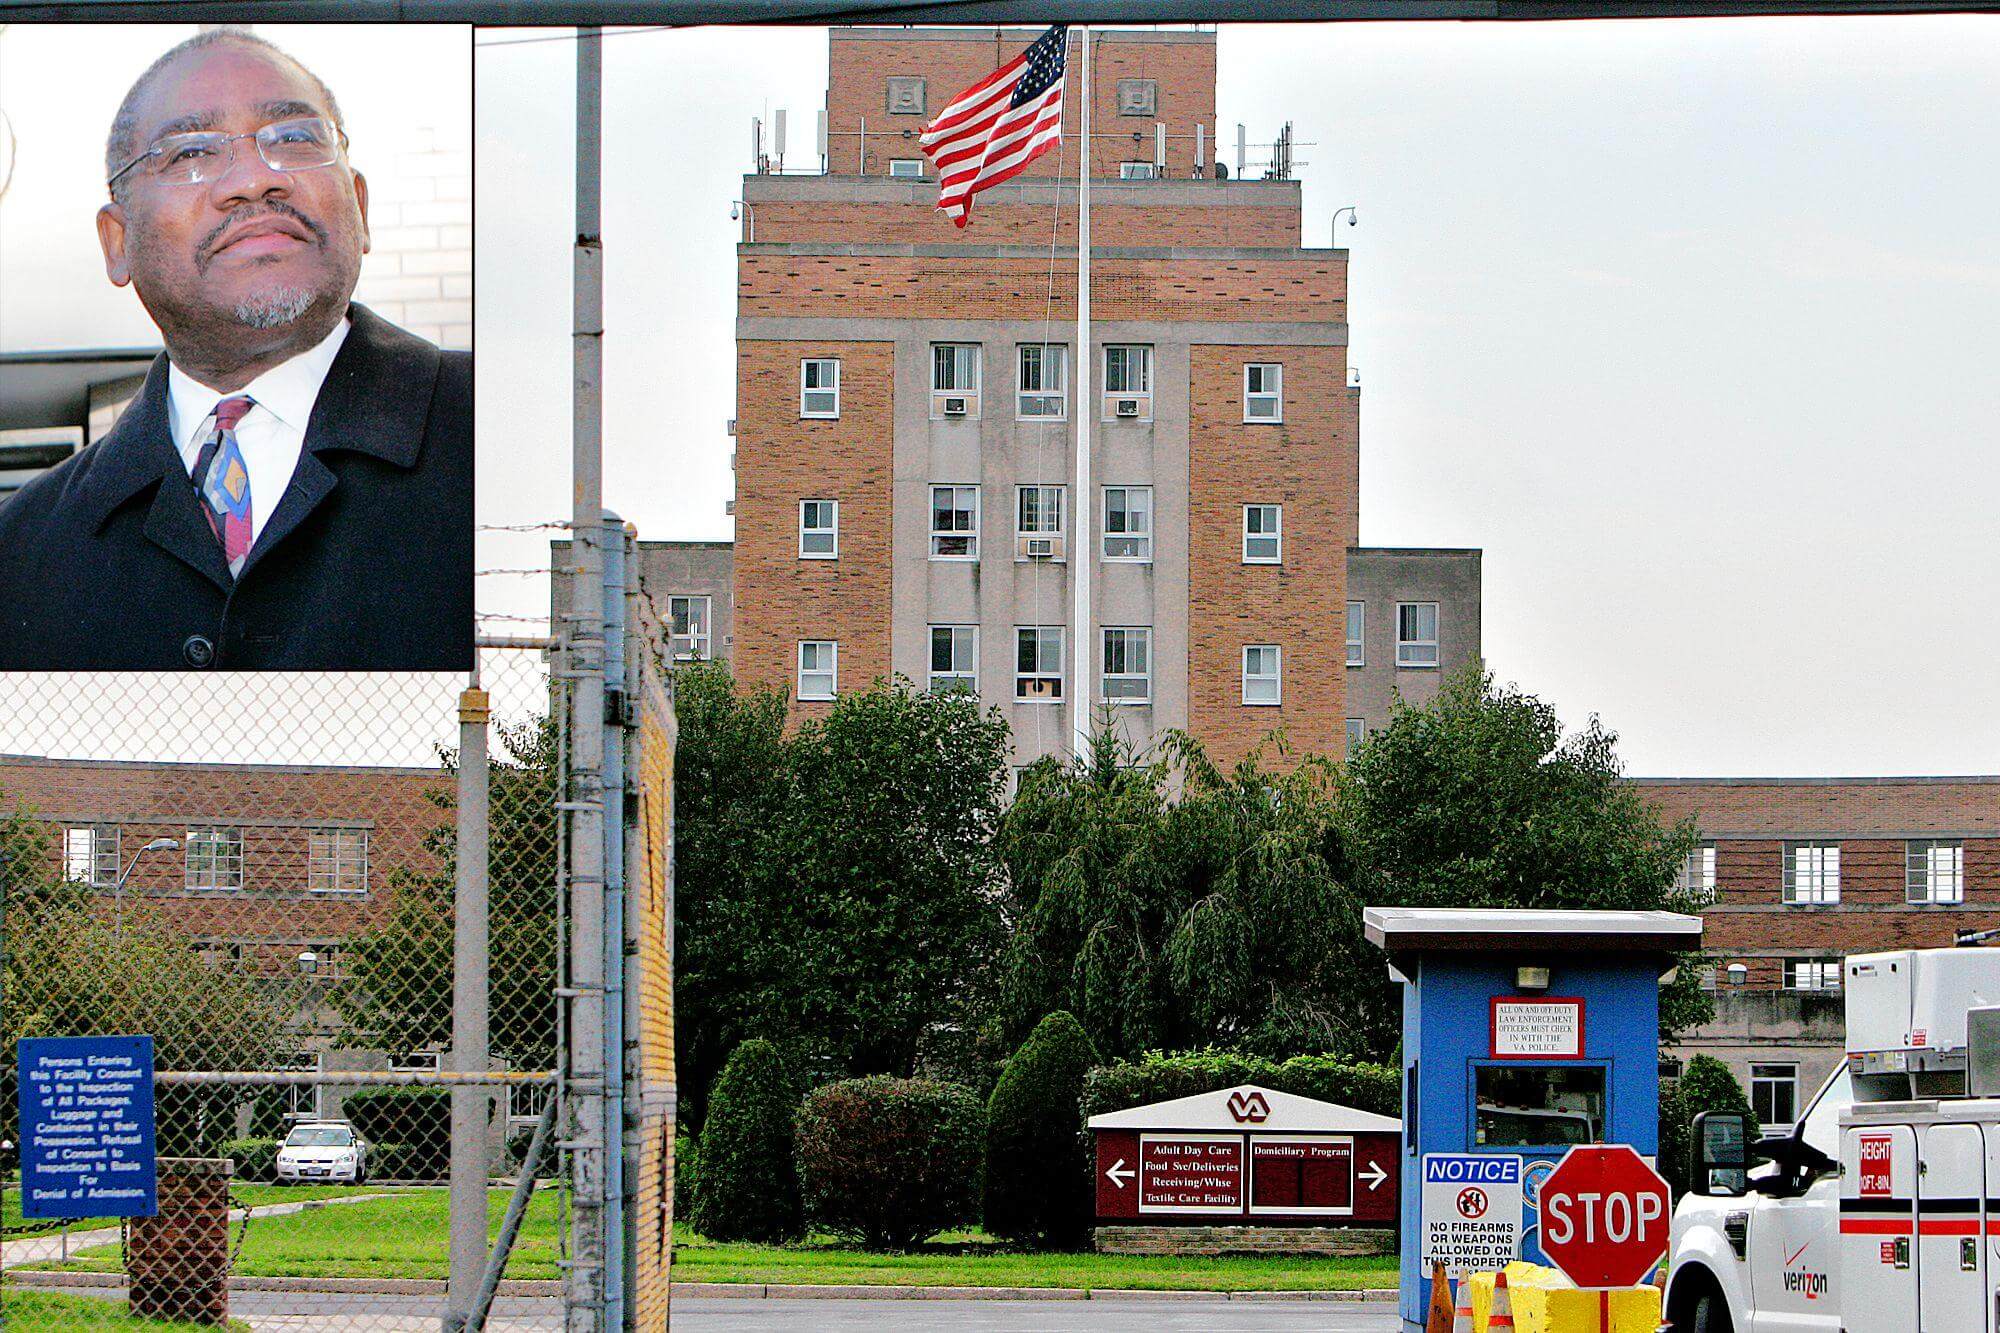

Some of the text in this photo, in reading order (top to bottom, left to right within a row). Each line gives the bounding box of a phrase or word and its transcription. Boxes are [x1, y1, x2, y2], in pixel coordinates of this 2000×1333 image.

[1554, 1006, 1572, 1014] DUTY
[1499, 1015, 1573, 1023] LAW ENFORCEMENT
[1499, 1024, 1573, 1033] OFFICERS MUST CHECK
[1509, 1034, 1562, 1042] IN WITH THE
[39, 1056, 132, 1067] Persons Entering
[30, 1068, 142, 1081] this Facility Consent
[39, 1082, 134, 1094] to the Inspection
[42, 1097, 54, 1106] of
[58, 1096, 73, 1106] All
[1227, 1092, 1271, 1122] VA
[50, 1109, 123, 1121] Luggage and
[36, 1121, 139, 1133] Containers in their
[102, 1135, 142, 1145] Refusal
[45, 1148, 124, 1160] of Consent to
[1153, 1145, 1232, 1156] Adult Day Care
[1254, 1146, 1350, 1157] Domiciliary Program
[1860, 1141, 1891, 1161] HEIGHT
[36, 1163, 91, 1173] Inspection
[111, 1161, 141, 1171] Basis
[1145, 1161, 1239, 1172] Food Svc/Deliveries
[1429, 1161, 1517, 1180] NOTICE
[79, 1175, 98, 1185] For
[1152, 1177, 1232, 1189] Receiving/Whse
[33, 1189, 67, 1200] Denial
[71, 1188, 84, 1199] of
[1145, 1193, 1237, 1205] Textile Care Facility
[1548, 1191, 1662, 1244] STOP
[1430, 1222, 1514, 1233] NO FIREARMS
[1430, 1233, 1513, 1244] OR WEAPONS
[1430, 1245, 1512, 1255] ALLOWED ON
[1784, 1265, 1827, 1299] verizon
